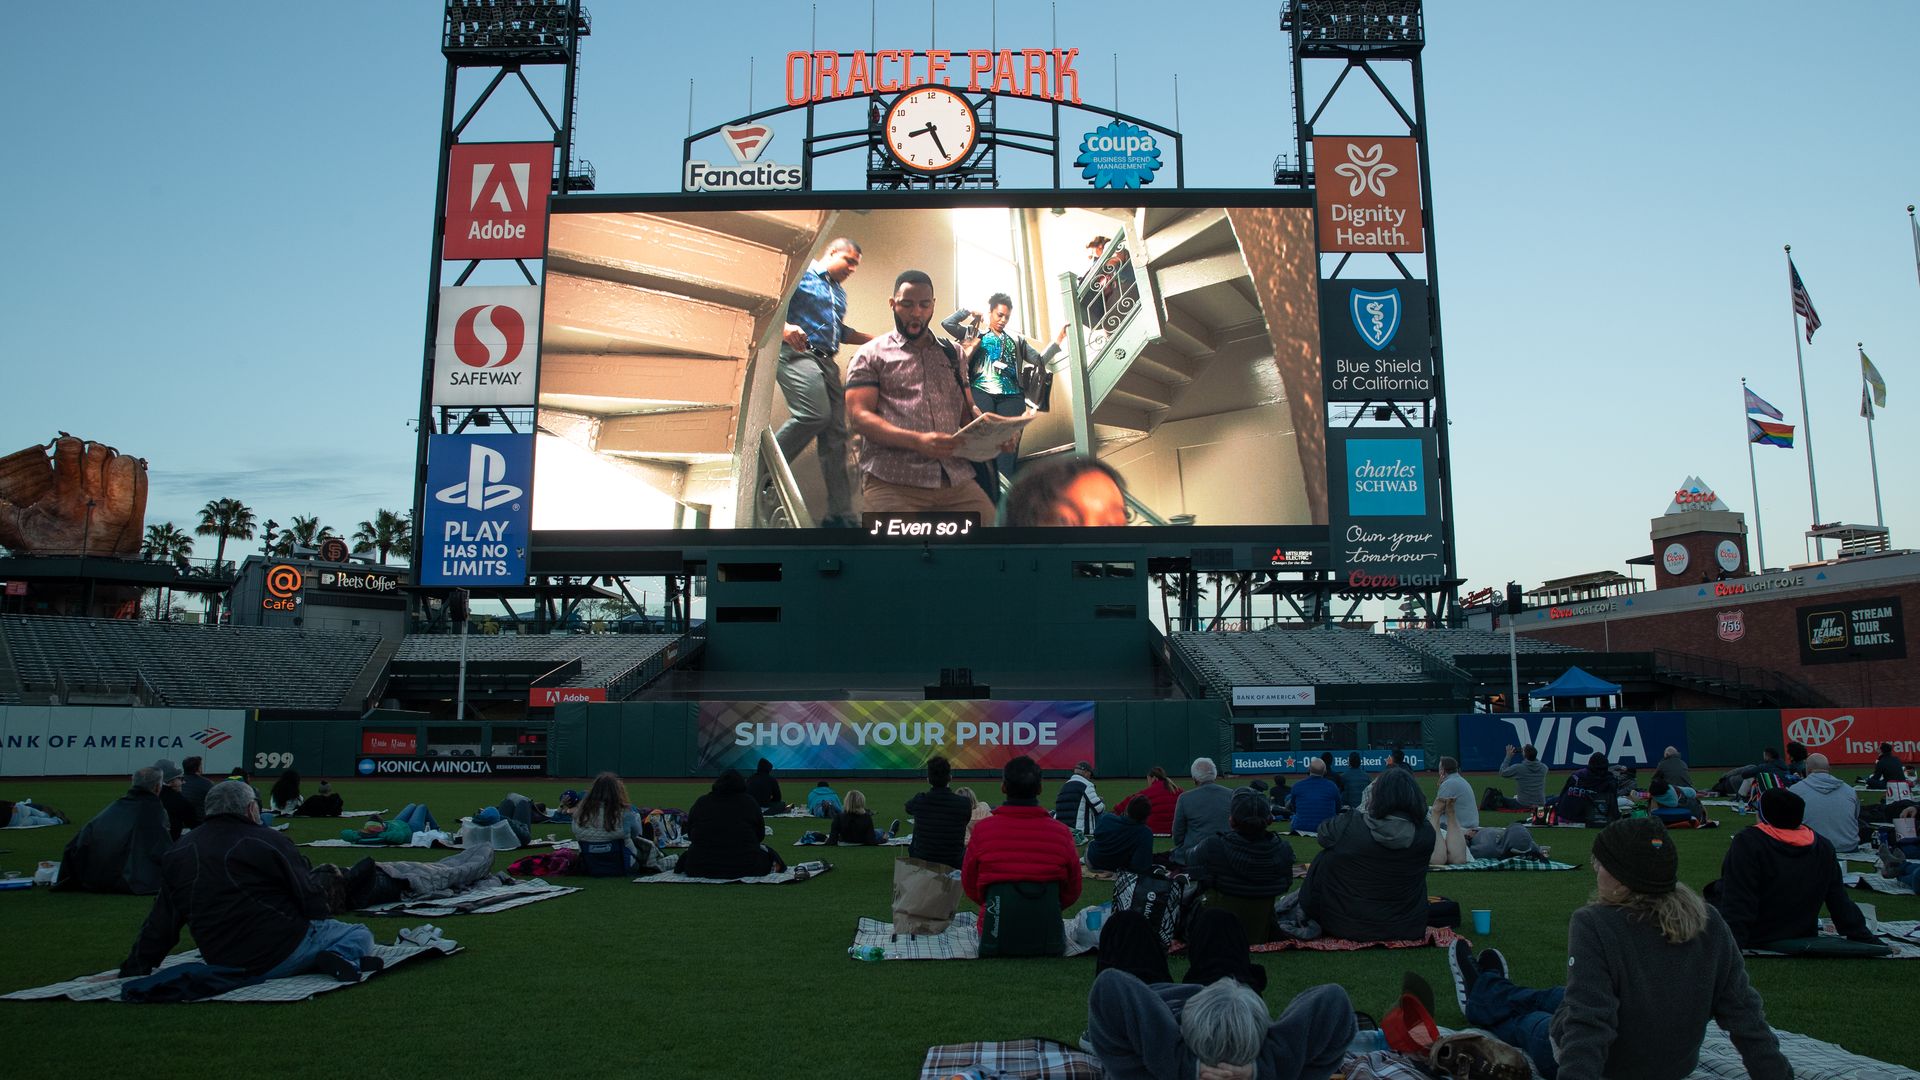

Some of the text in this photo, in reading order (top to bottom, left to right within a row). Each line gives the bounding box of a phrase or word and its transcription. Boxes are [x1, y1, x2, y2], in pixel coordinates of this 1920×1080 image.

[786, 48, 1082, 106] ORACLE PARK
[1088, 136, 1153, 156] coupa
[690, 164, 800, 186] Fanatics
[1332, 204, 1406, 227] Dignity
[468, 220, 526, 239] Adobe
[1337, 227, 1404, 245] Health
[1337, 360, 1421, 373] Blue Shield
[450, 372, 522, 385] SAFEWAY
[1332, 376, 1428, 389] of California
[1355, 460, 1415, 478] charles
[1356, 481, 1417, 492] SCHWAB
[1675, 490, 1716, 504] Coors
[444, 521, 509, 541] PLAY
[887, 519, 957, 535] Even so
[1347, 525, 1432, 551] Own your
[444, 545, 507, 558] HAS NO
[267, 565, 302, 598] @
[337, 572, 396, 592] Peet's Coffee
[1349, 569, 1440, 587] Coors LIGHT
[1715, 577, 1803, 596] Coors LIGHT COVE
[263, 598, 294, 610] Café
[1550, 602, 1616, 619] Coors LIGHT COVE
[1851, 607, 1893, 620] STREAM
[1721, 620, 1740, 632] 756
[1821, 618, 1835, 628] MY
[1853, 621, 1879, 633] YOUR
[1813, 627, 1843, 638] TEAMS
[1854, 633, 1894, 646] GIANTS.
[563, 693, 590, 702] Adobe
[49, 735, 77, 748] OF
[83, 735, 183, 748] AMERICA
[735, 722, 1057, 746] SHOW YOUR PRIDE
[1500, 716, 1648, 765] VISA
[255, 752, 294, 769] 399
[378, 761, 430, 773] KONICA
[432, 761, 492, 773] MINOLTA
[1235, 758, 1282, 768] Heineken
